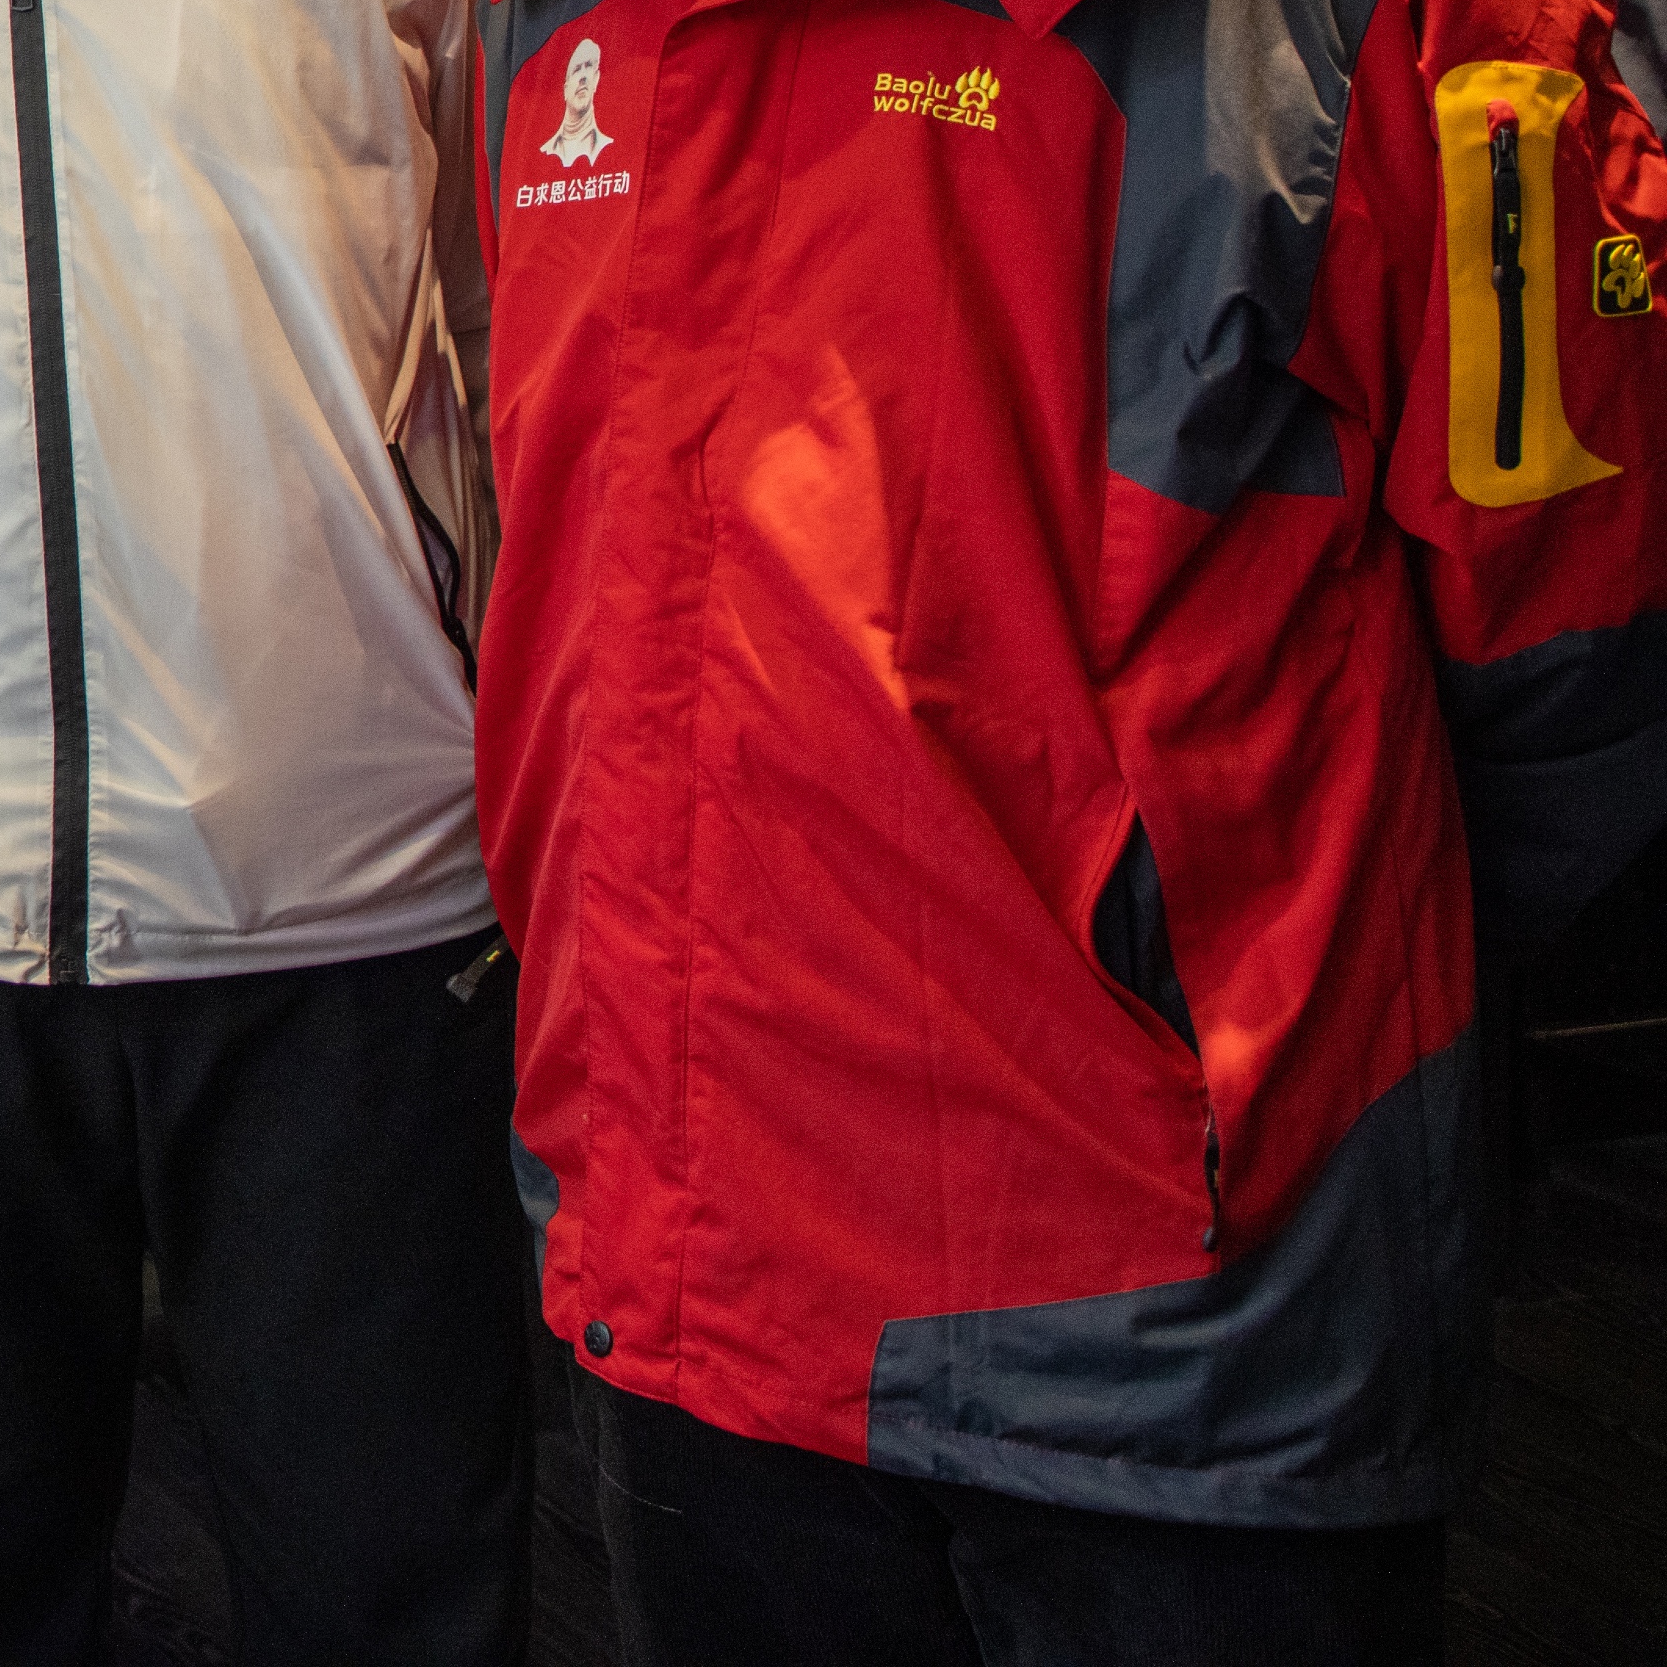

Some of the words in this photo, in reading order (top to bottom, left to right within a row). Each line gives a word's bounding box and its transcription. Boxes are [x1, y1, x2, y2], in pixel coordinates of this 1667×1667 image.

[874, 73, 951, 100] Baolu
[516, 170, 630, 208] 白求恩公益行动
